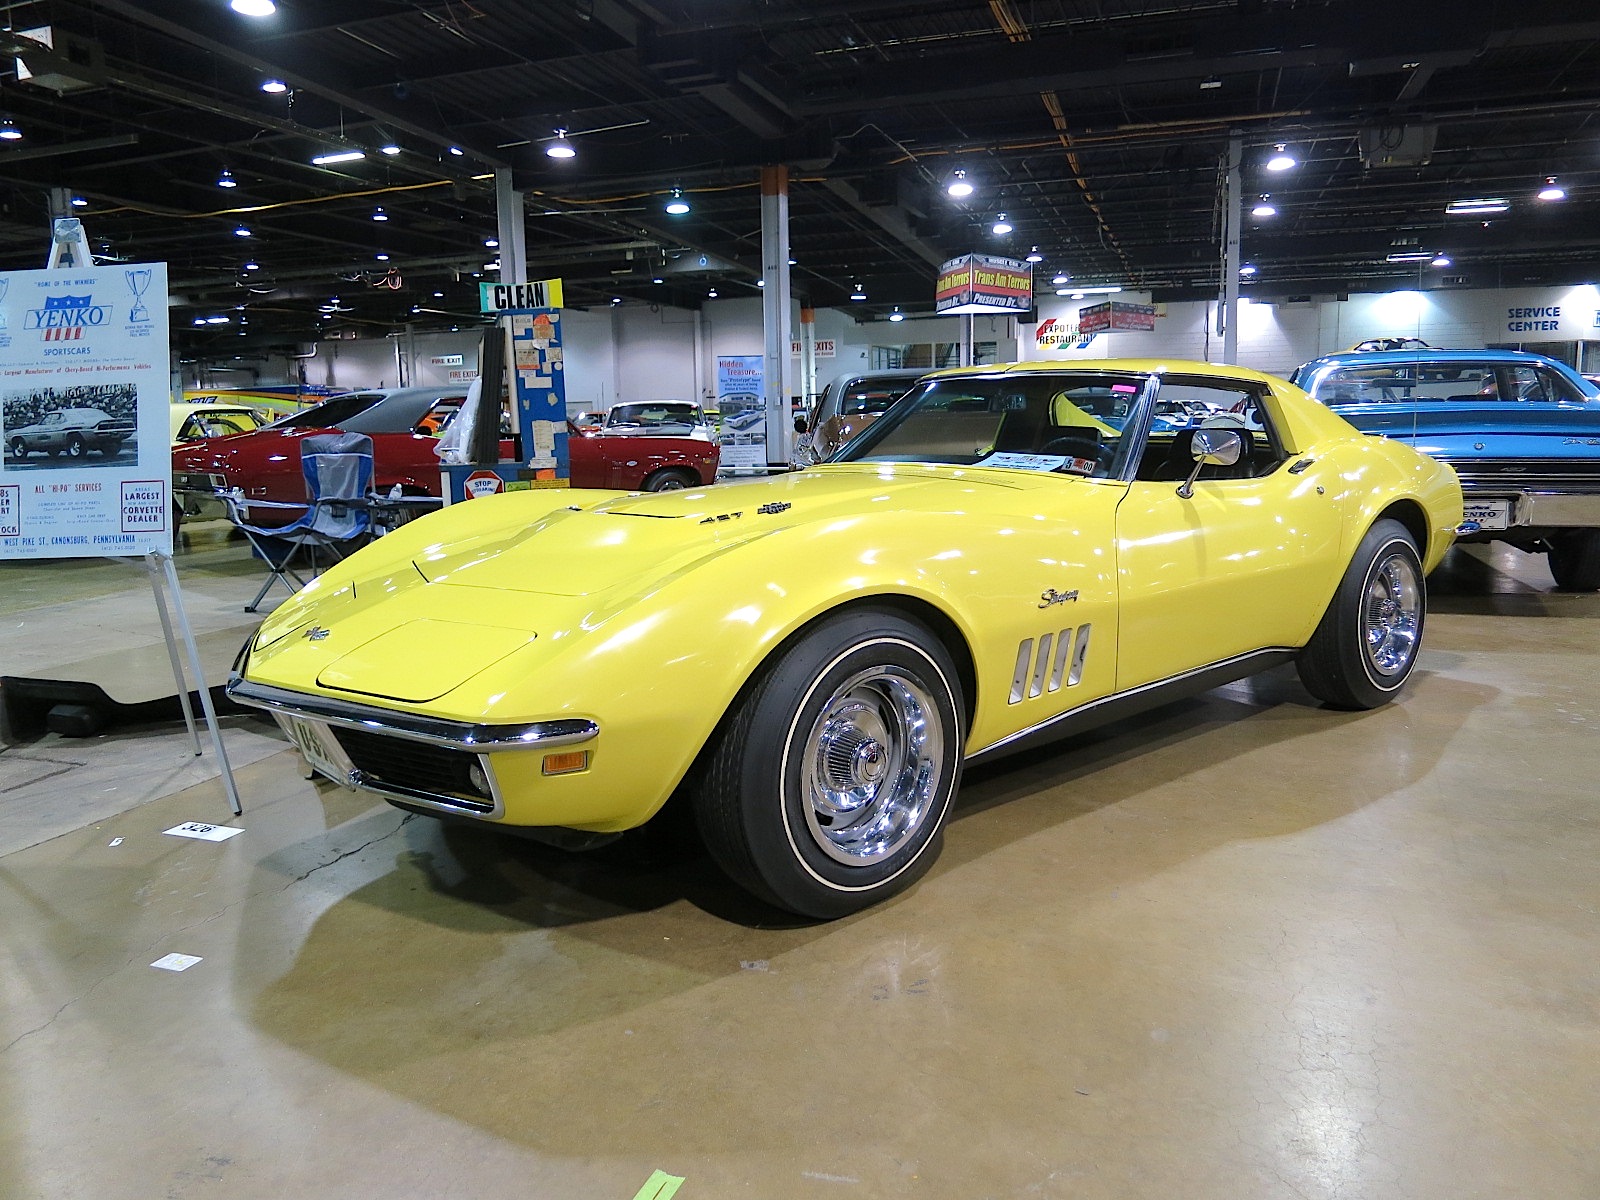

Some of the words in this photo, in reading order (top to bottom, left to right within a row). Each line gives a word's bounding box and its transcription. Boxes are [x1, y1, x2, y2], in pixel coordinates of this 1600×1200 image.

[974, 269, 995, 287] Trans
[994, 273, 1007, 288] Am
[1007, 274, 1031, 291] Terrors
[494, 283, 545, 310] CLEAN
[34, 306, 104, 328] YENKO
[1508, 306, 1561, 318] SERVICE
[1508, 320, 1559, 332] CENTER
[1039, 333, 1095, 345] RESTAURANT
[44, 346, 91, 356] SPORTSCARS
[720, 360, 744, 368] Hidden
[462, 370, 477, 378] EXITS
[1065, 459, 1072, 469] 5
[1083, 462, 1092, 472] 00
[35, 485, 46, 494] ALL
[74, 482, 102, 492] SERVICES
[125, 492, 160, 500] LARGEST
[123, 506, 163, 514] CORVETTE
[128, 514, 158, 523] DEALER
[4, 538, 18, 546] WEST
[22, 537, 35, 546] PIKE
[94, 534, 136, 544] PENNSYLVANIA
